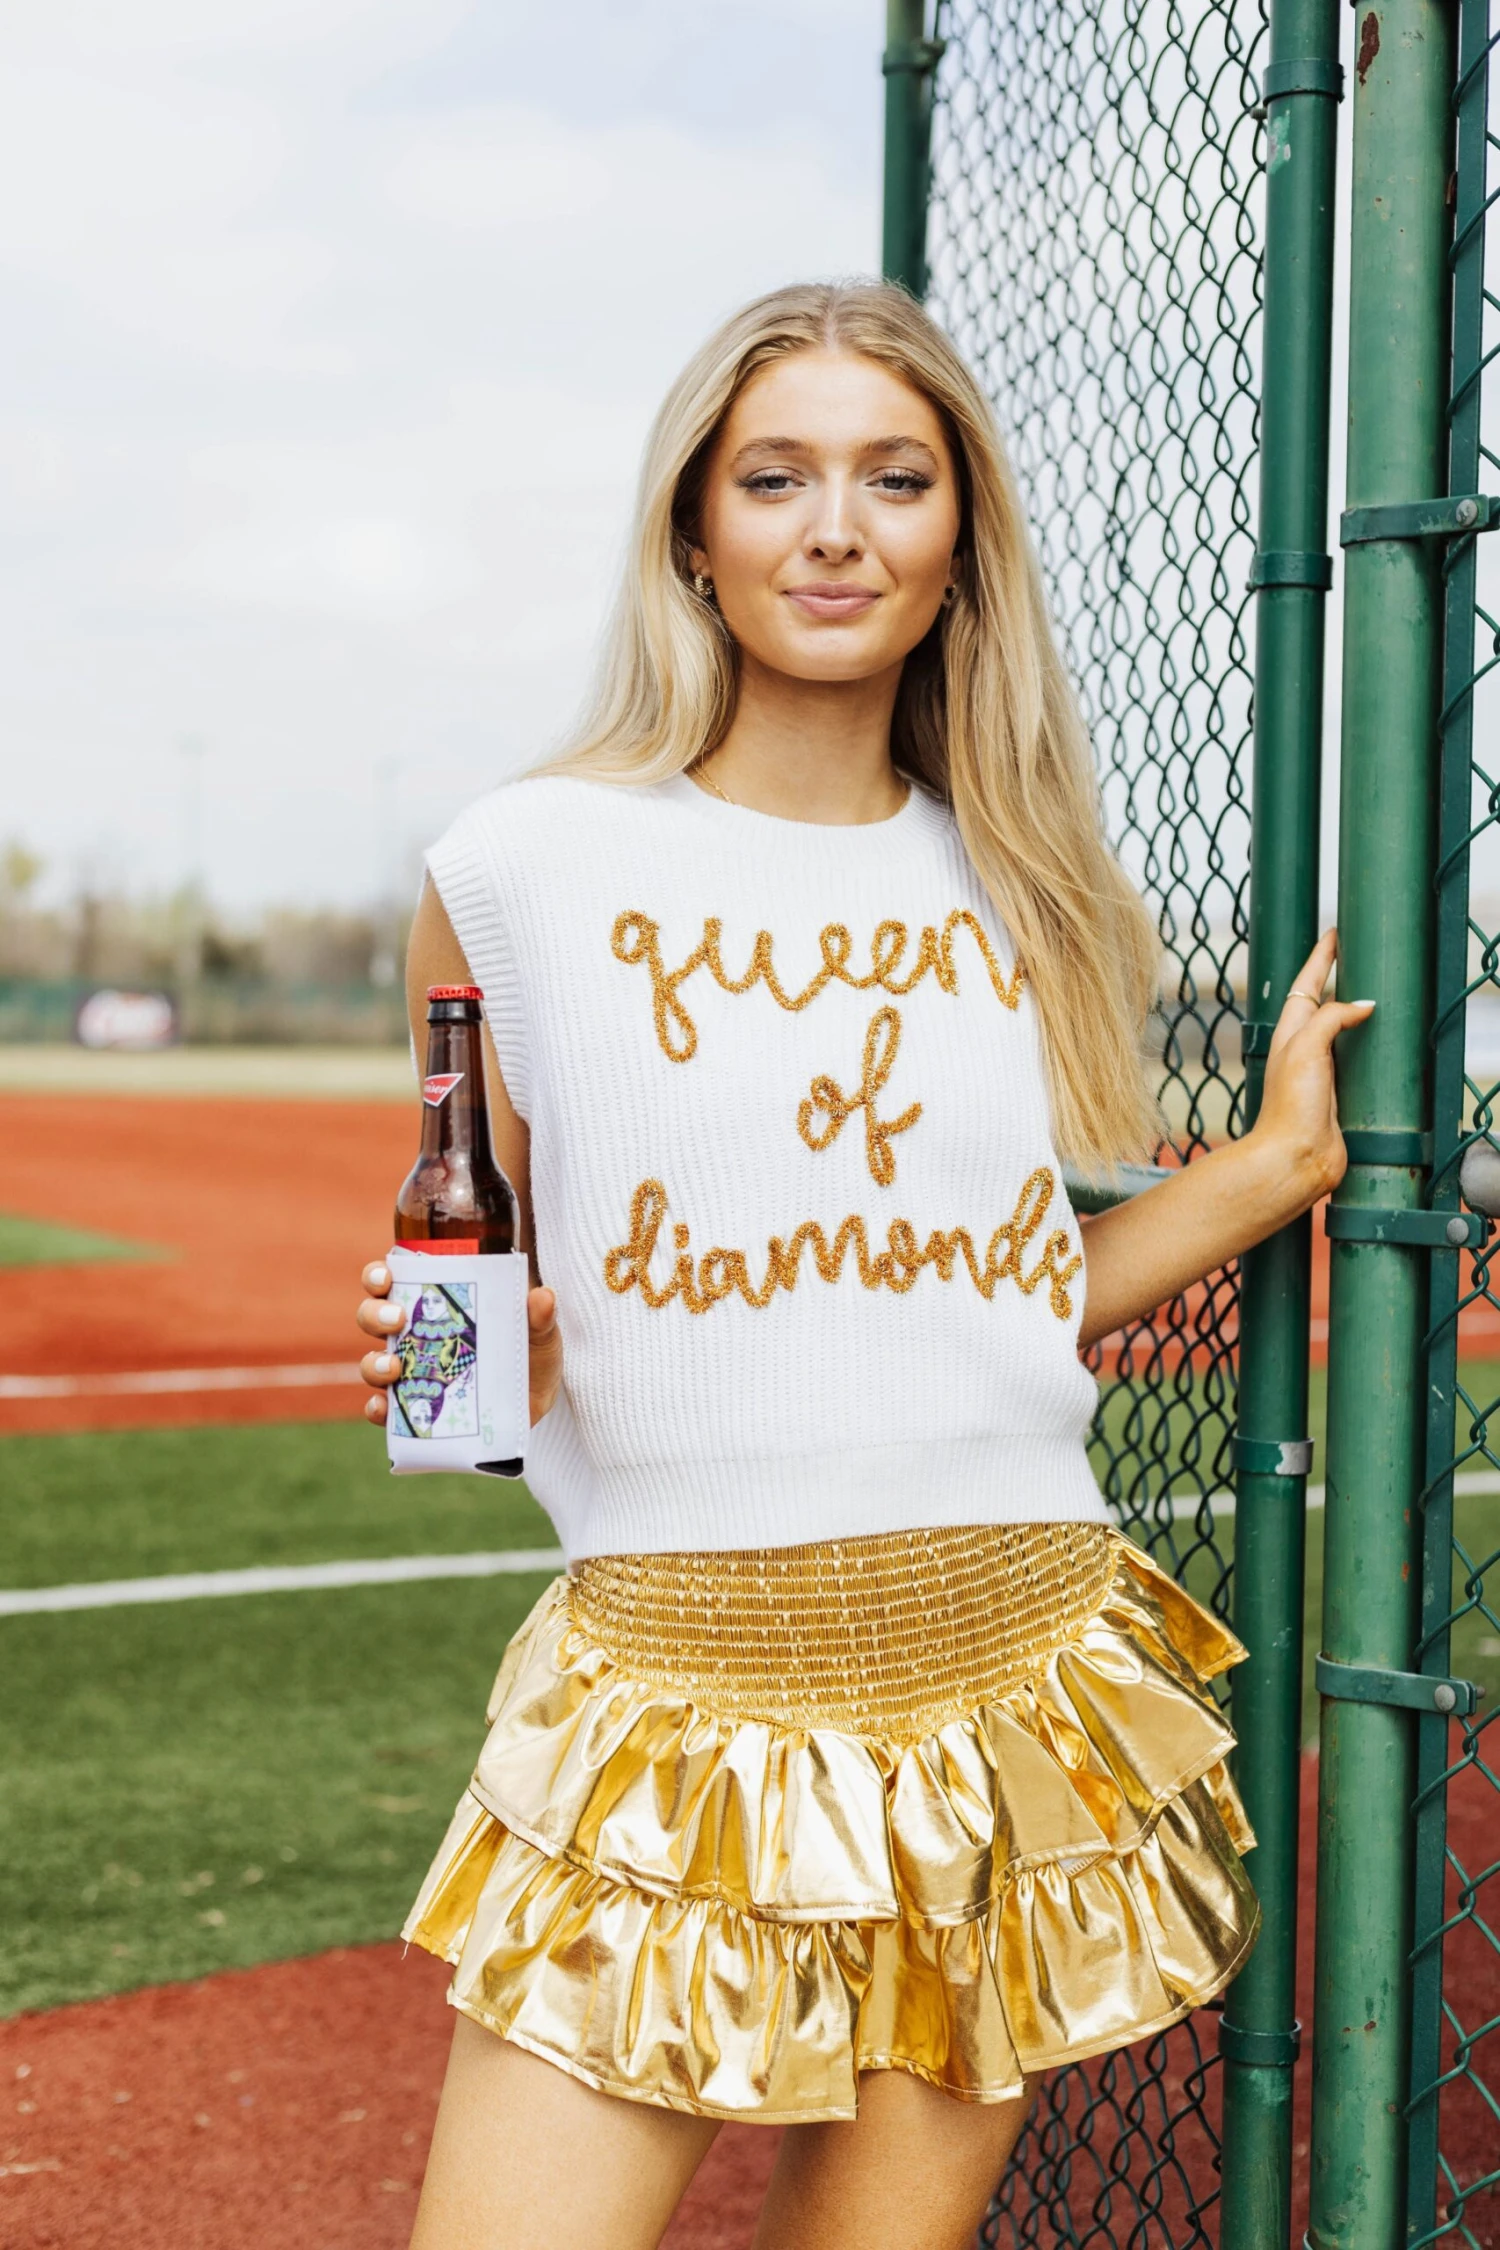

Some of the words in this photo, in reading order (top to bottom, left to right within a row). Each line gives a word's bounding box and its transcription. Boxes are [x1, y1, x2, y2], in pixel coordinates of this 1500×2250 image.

[610, 909, 1026, 1063] queen
[797, 1005, 924, 1187] of
[604, 1166, 1083, 1320] diamonds
